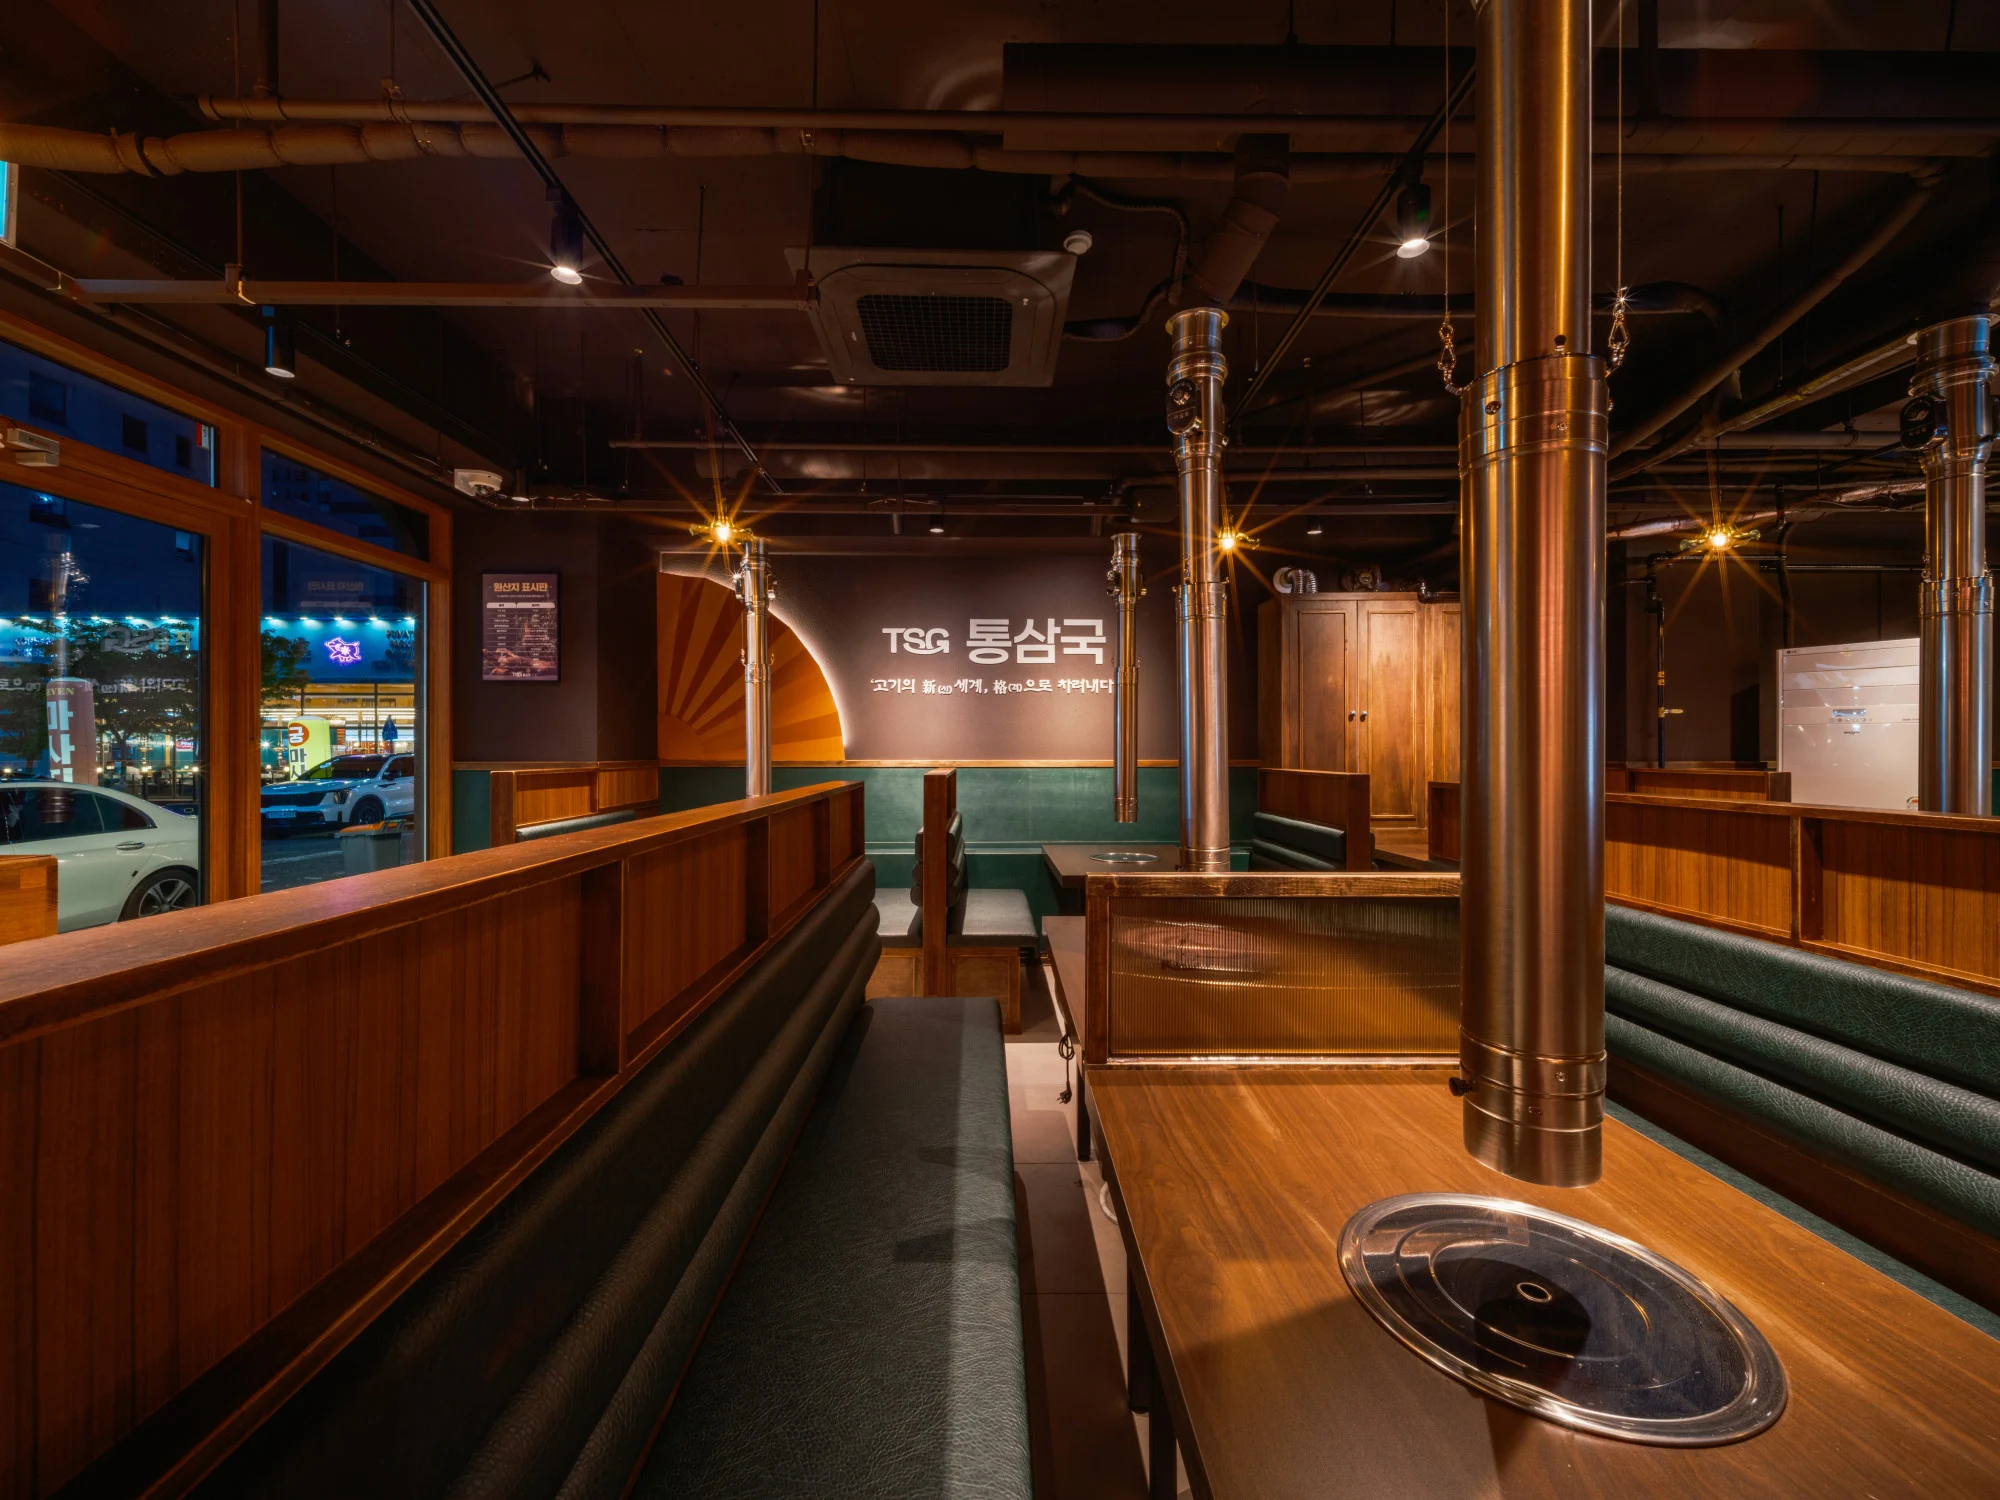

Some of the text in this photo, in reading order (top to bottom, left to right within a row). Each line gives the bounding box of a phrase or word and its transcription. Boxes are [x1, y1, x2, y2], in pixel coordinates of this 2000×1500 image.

[493, 582, 549, 592] 원산지 표시판
[882, 618, 1107, 665] TSG 통삼국
[1057, 678, 1115, 694] 차려내다
